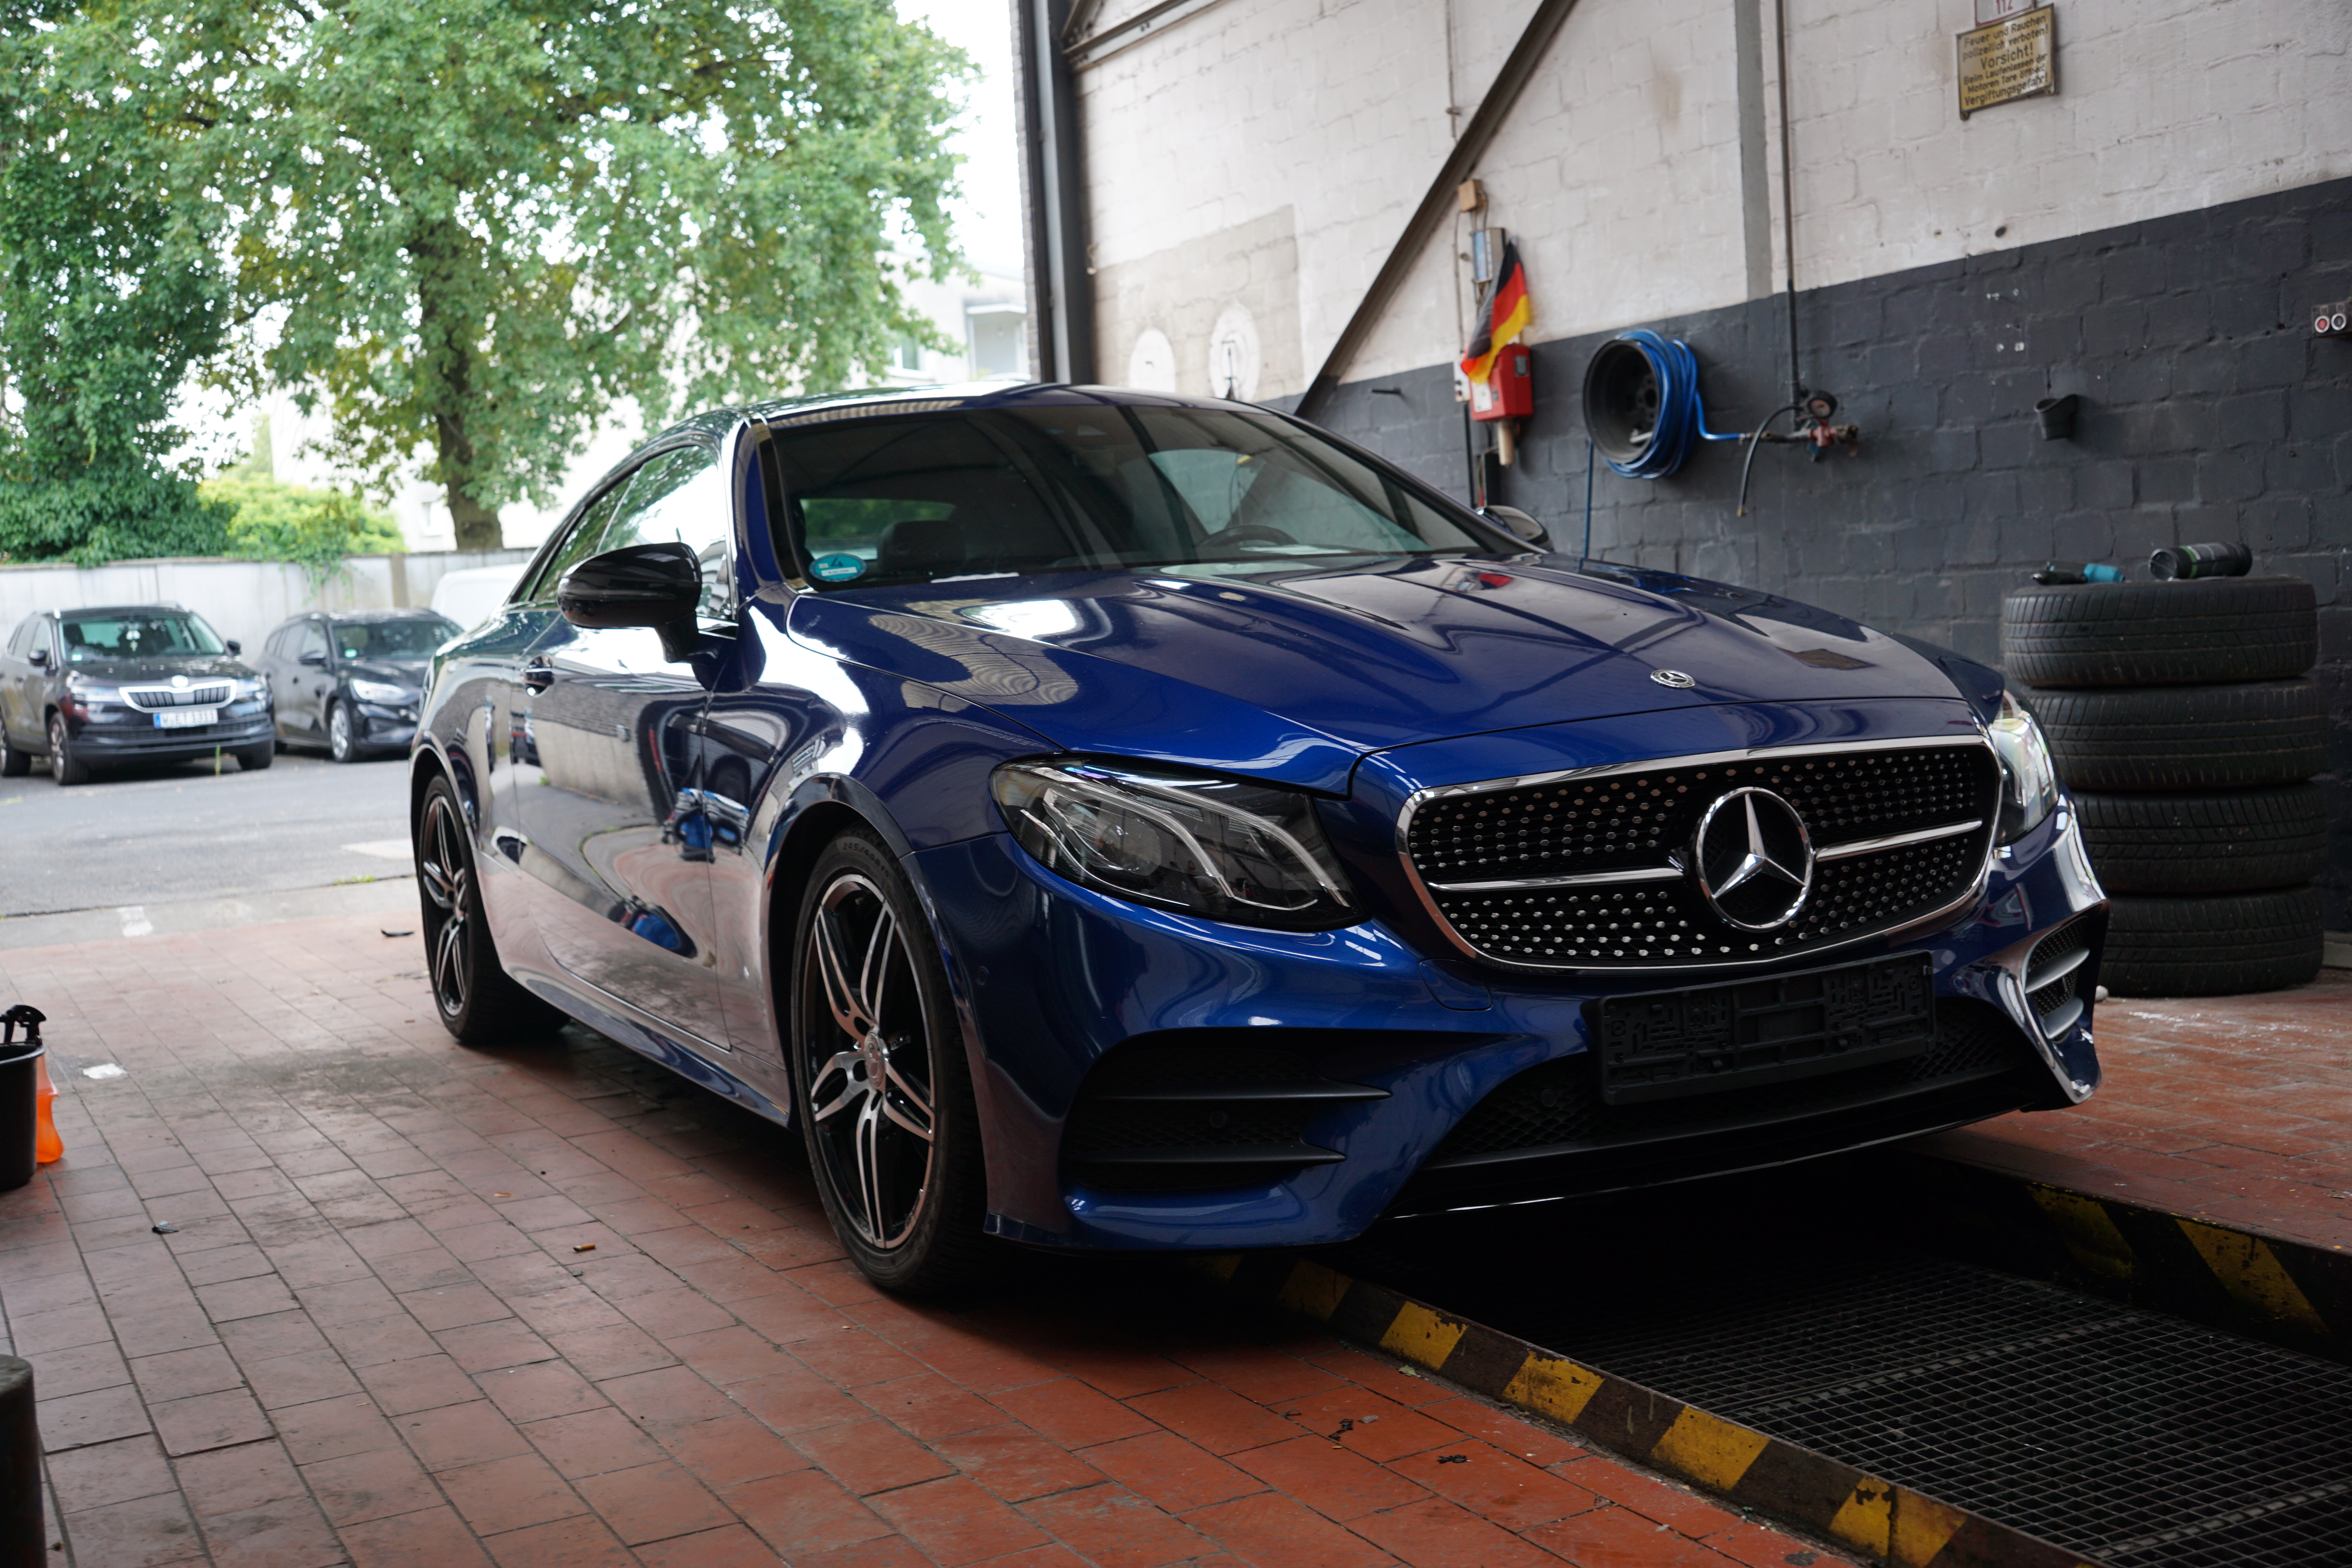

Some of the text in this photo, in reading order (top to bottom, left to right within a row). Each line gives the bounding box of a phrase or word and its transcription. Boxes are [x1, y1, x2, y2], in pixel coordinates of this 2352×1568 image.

[1963, 24, 2048, 61] polizeilich verboten!
[1964, 15, 2046, 48] Feuer und Rauchen
[1964, 53, 2047, 85] Beim Laufenlassen der
[1980, 42, 2033, 70] Vorsicht!
[1965, 72, 2048, 106] Vergiftungsgefahr!
[1967, 80, 1999, 94] Motoren
[2001, 74, 2017, 84] Tore
[831, 557, 843, 568] 4
